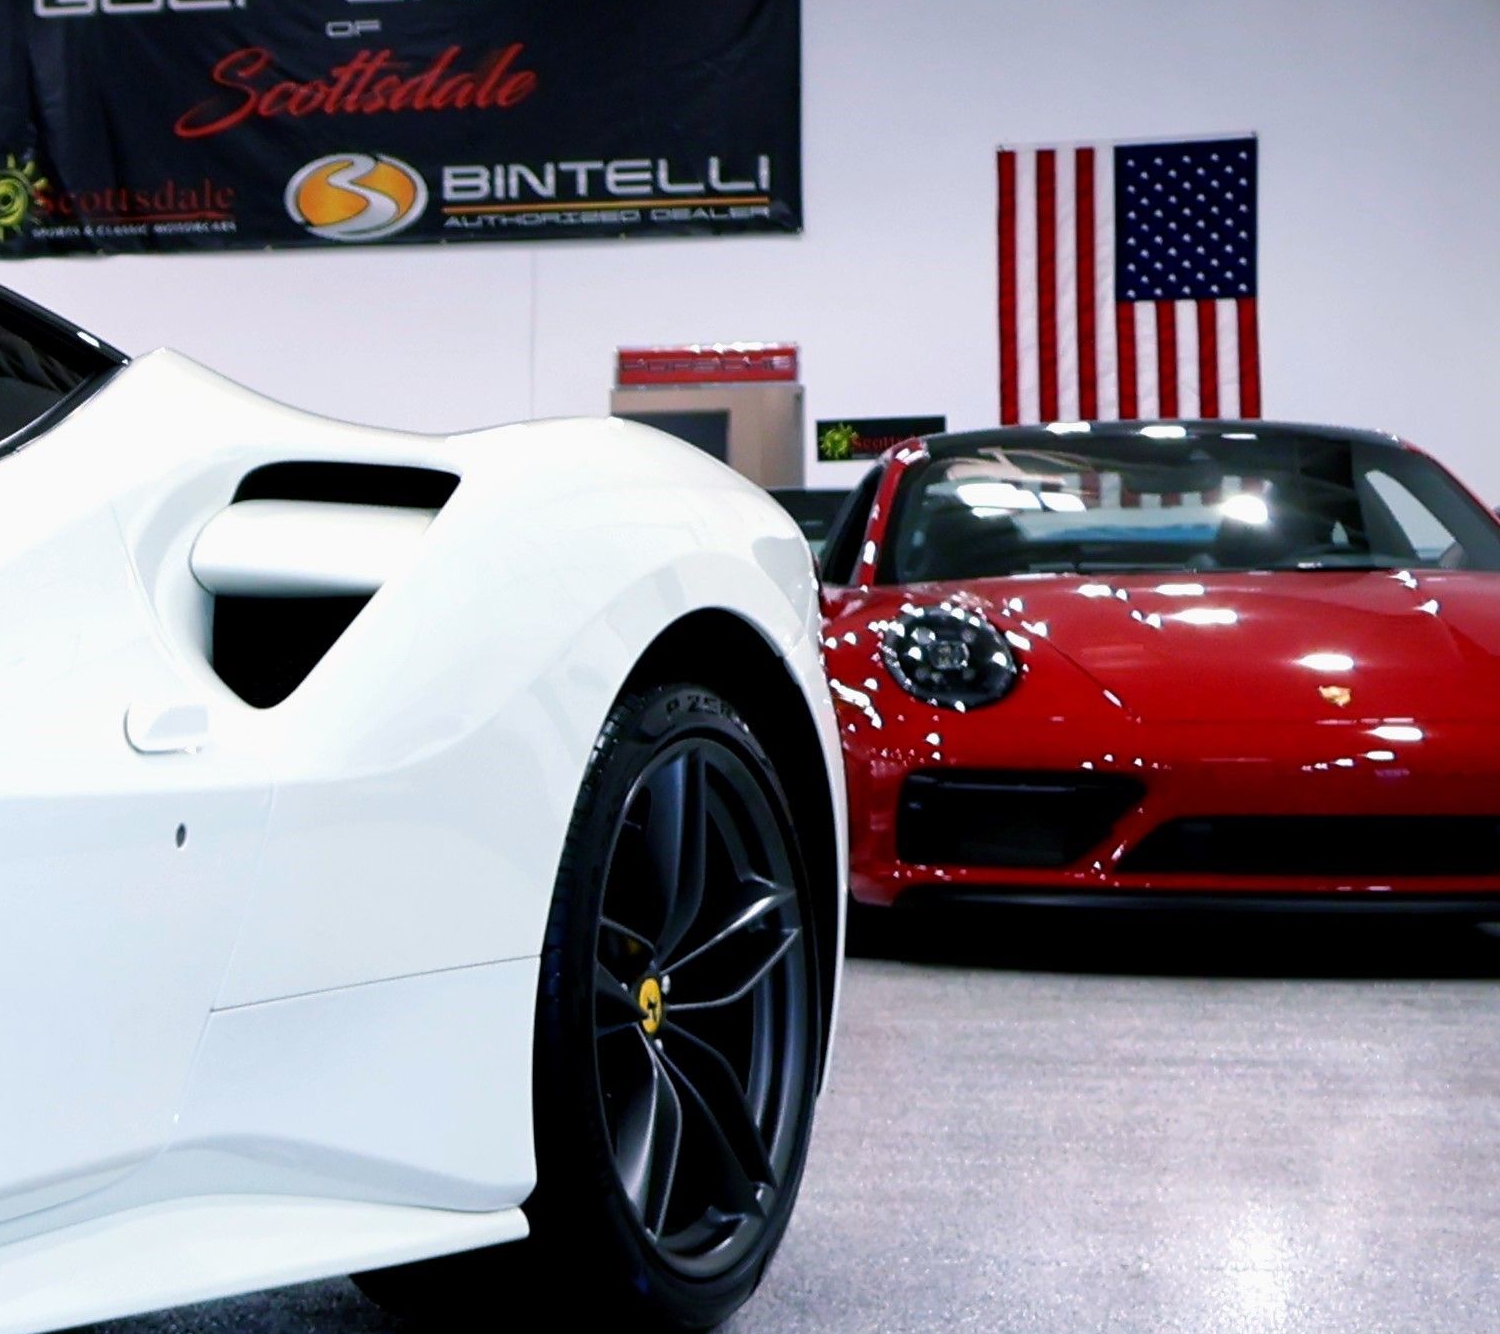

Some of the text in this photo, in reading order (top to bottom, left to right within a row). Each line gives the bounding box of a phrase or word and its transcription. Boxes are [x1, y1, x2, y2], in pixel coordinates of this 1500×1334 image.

[326, 20, 382, 38] OF
[173, 42, 538, 139] Scottsdale
[442, 154, 771, 201] BINTELLI
[32, 178, 237, 215] Scottsdale
[443, 206, 771, 229] AUTHORIZED DEALER
